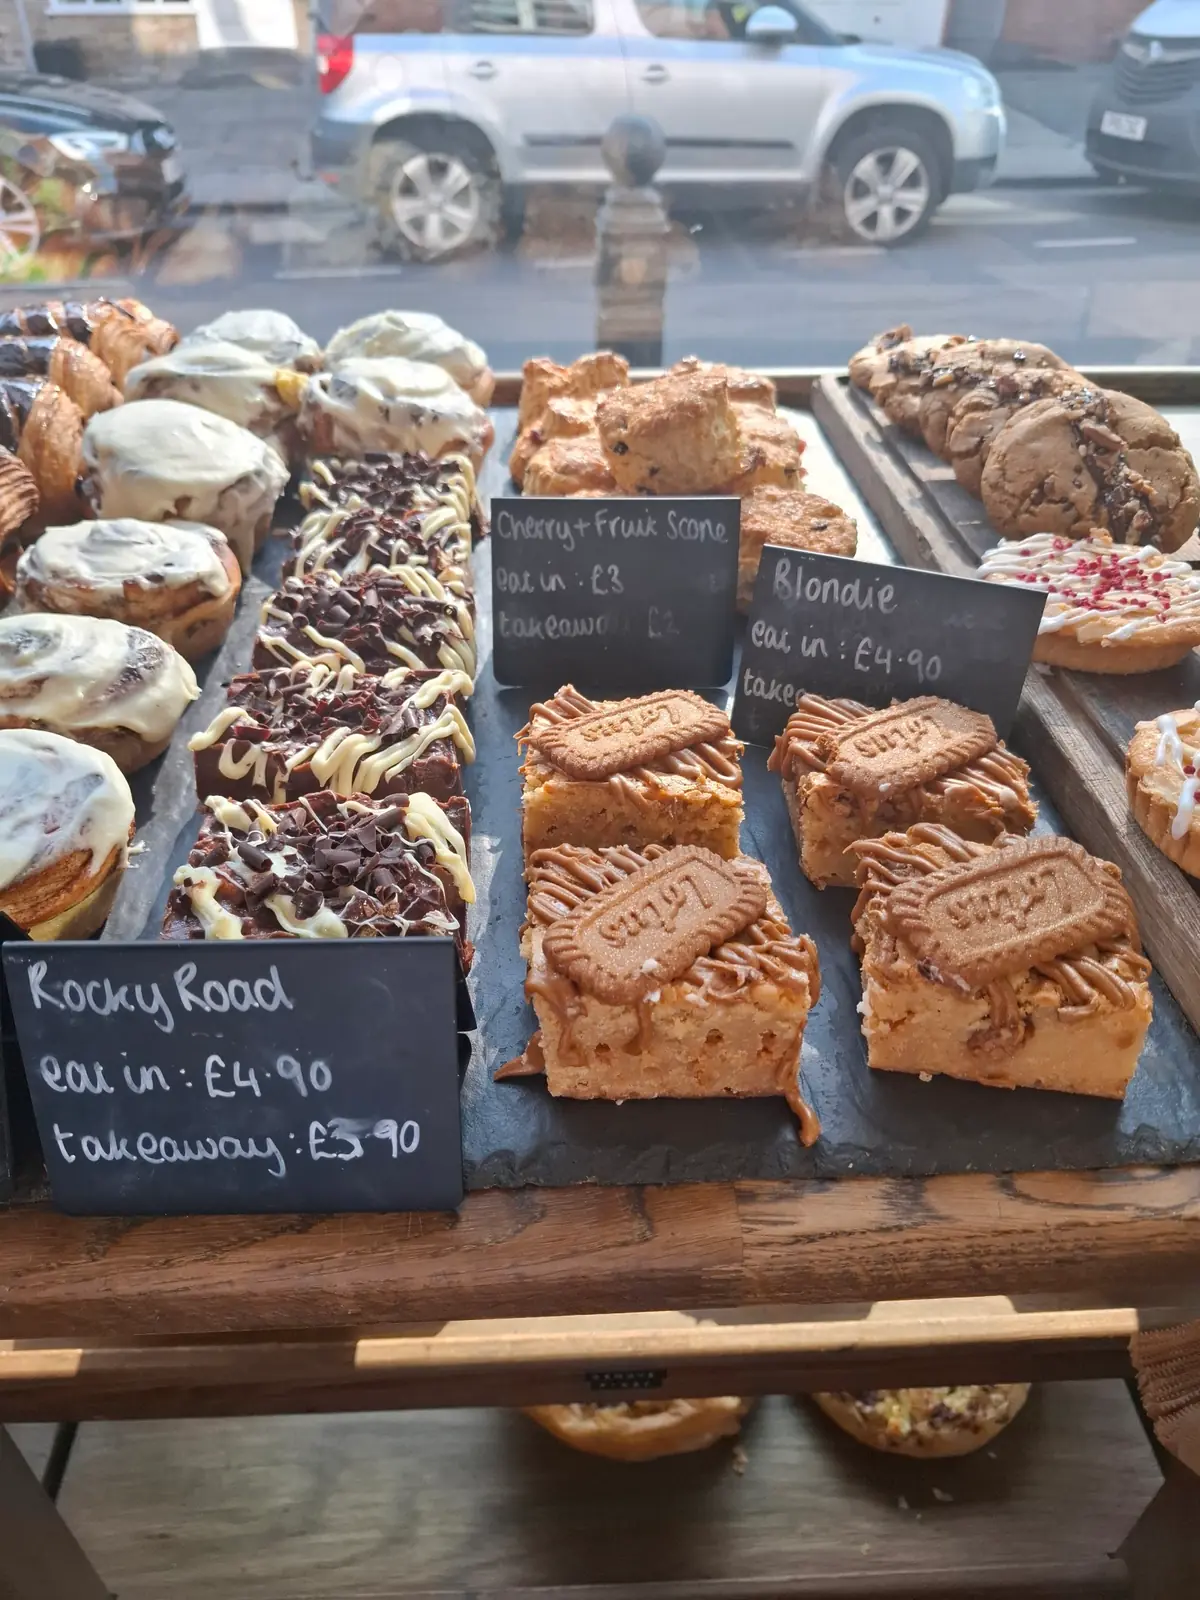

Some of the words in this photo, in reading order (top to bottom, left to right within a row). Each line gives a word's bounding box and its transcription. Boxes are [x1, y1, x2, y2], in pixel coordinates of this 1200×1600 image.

[667, 509, 729, 544] Scone
[496, 566, 535, 594] eat
[590, 563, 625, 596] £3
[773, 557, 899, 614] Blondie
[751, 619, 792, 654] eat
[599, 874, 713, 949] Lotus
[27, 959, 175, 1034] Rocky
[173, 960, 294, 1013] Road
[39, 1054, 115, 1094] eat
